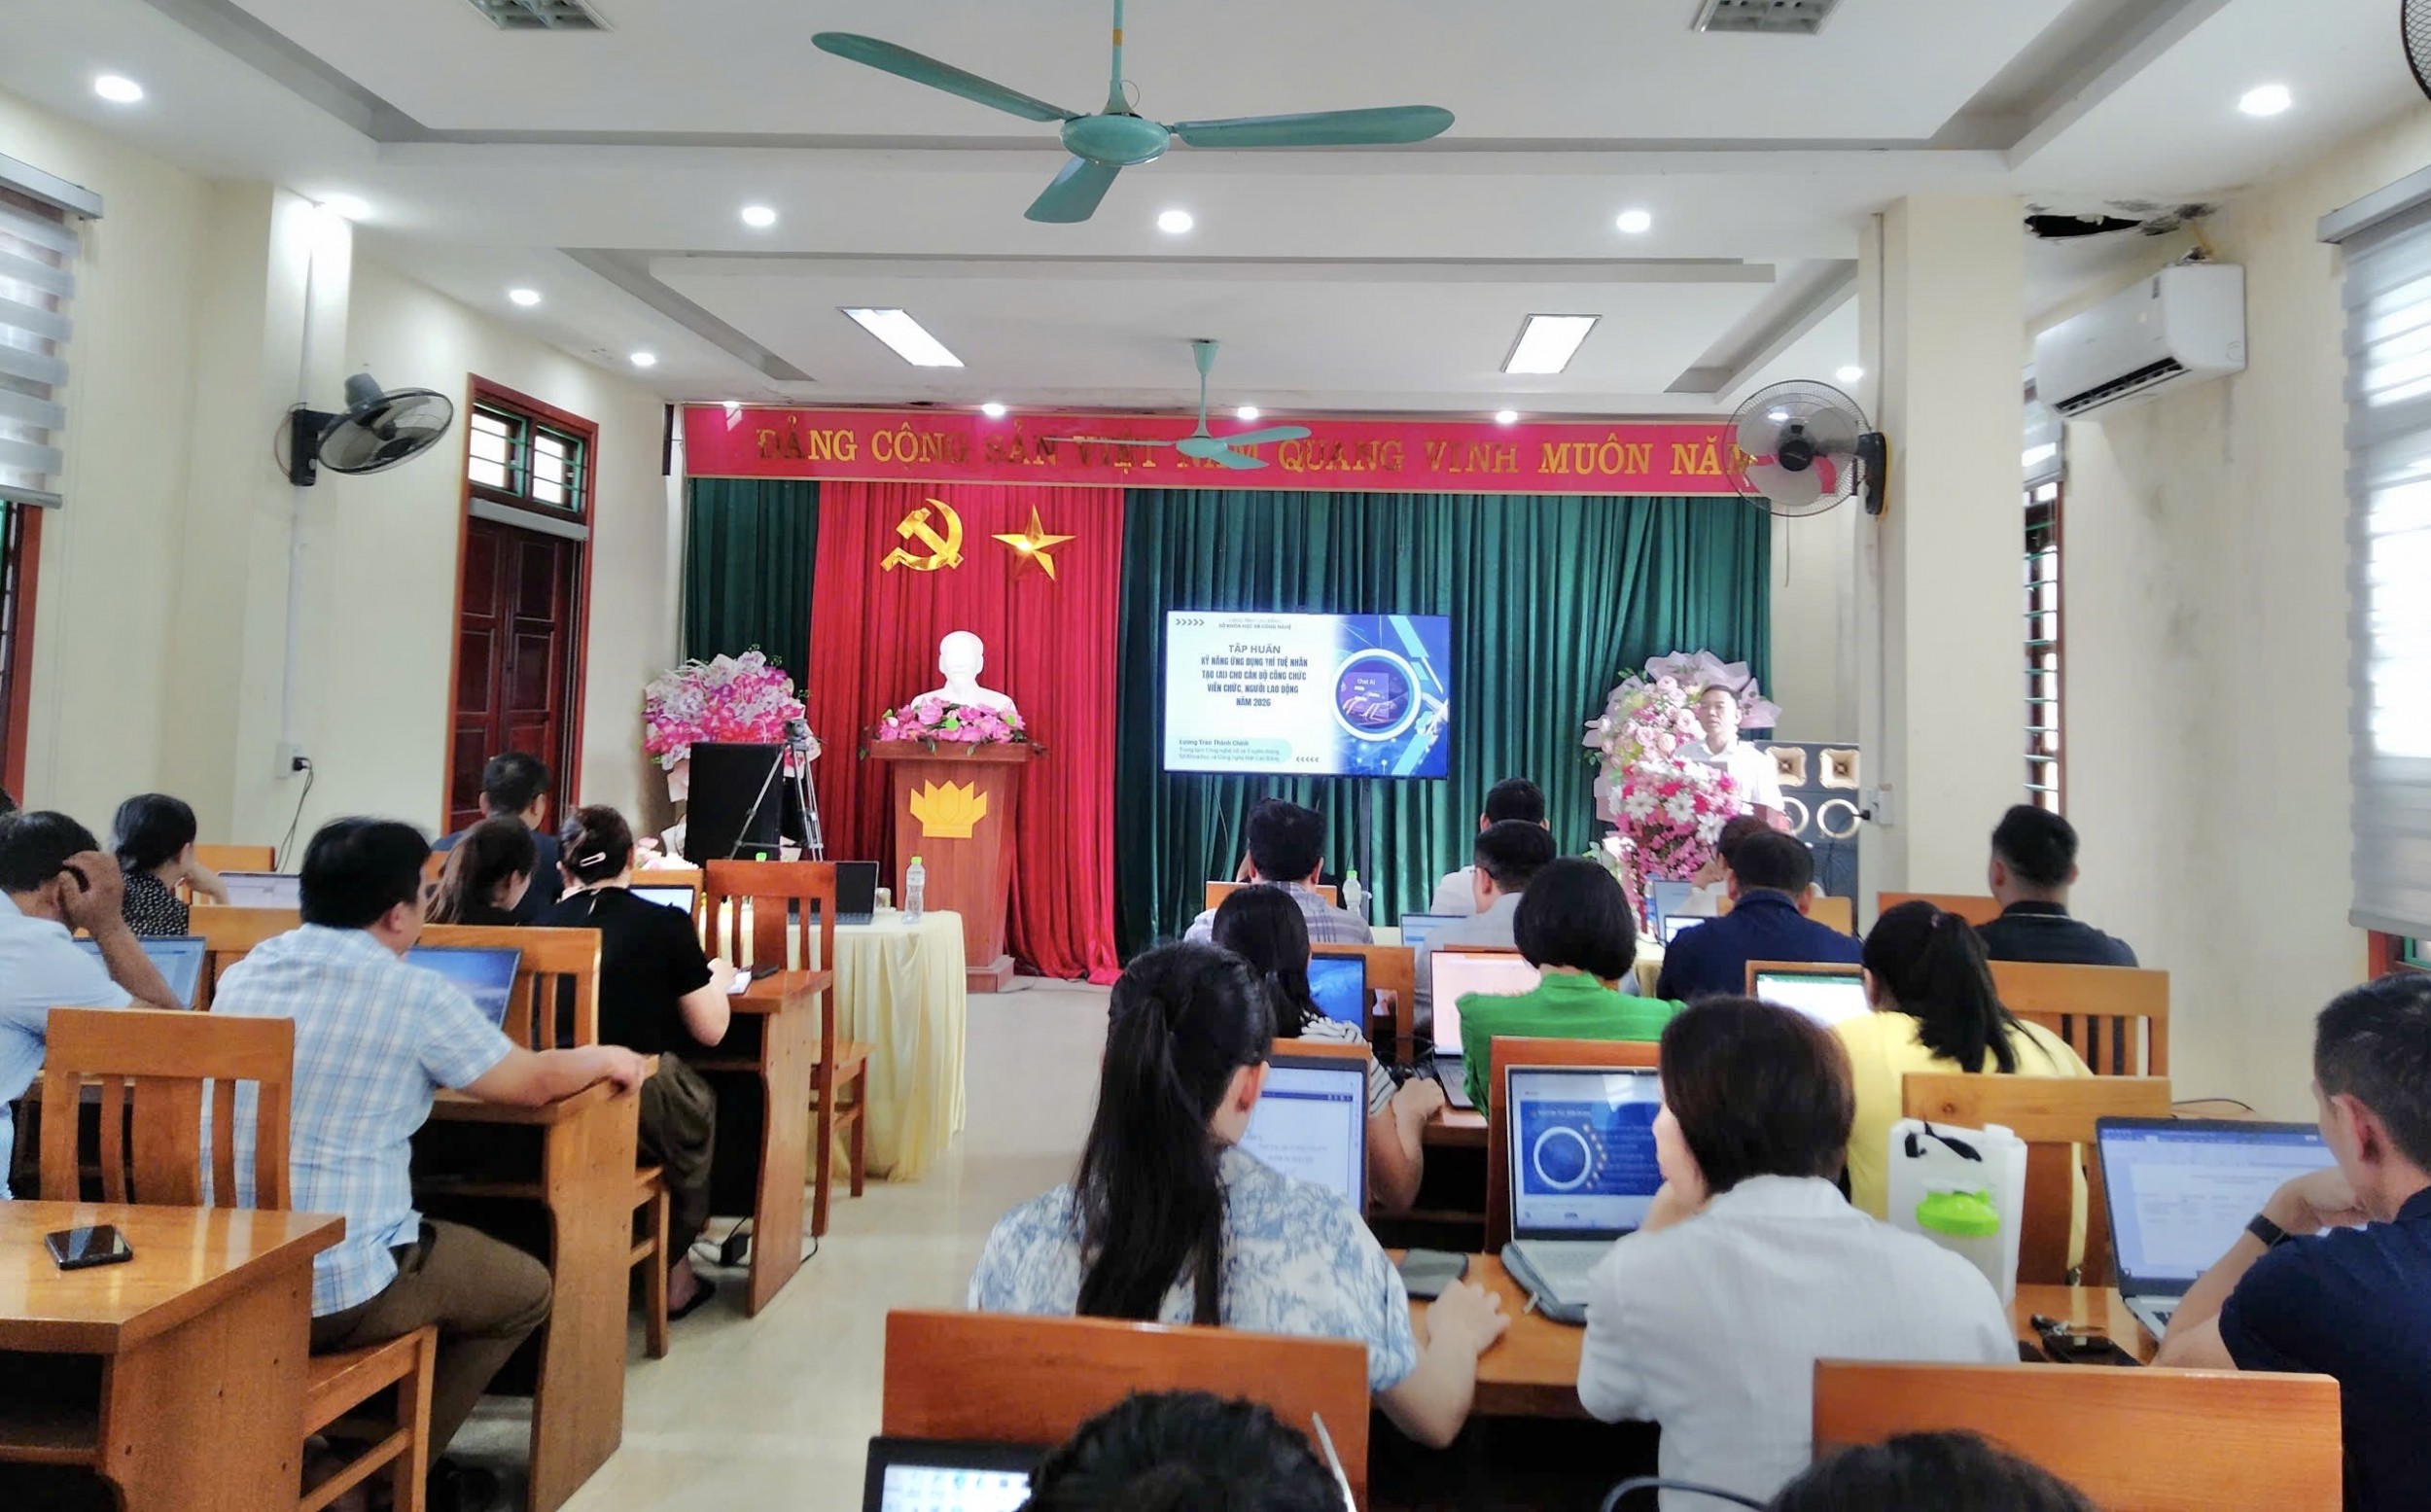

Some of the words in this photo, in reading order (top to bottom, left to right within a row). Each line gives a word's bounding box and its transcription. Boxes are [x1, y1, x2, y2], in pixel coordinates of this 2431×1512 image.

[871, 421, 968, 463] CÔNG
[1278, 439, 1406, 473] QUANG
[1423, 440, 1519, 474] VINH
[1537, 433, 1653, 475] MUÔN
[1228, 643, 1248, 654] TẬP
[1251, 643, 1281, 653] HUẤN
[1229, 670, 1242, 680] CHO
[1266, 685, 1280, 693] LAO
[1236, 695, 1251, 706] NĂM
[1252, 697, 1271, 707] 2026
